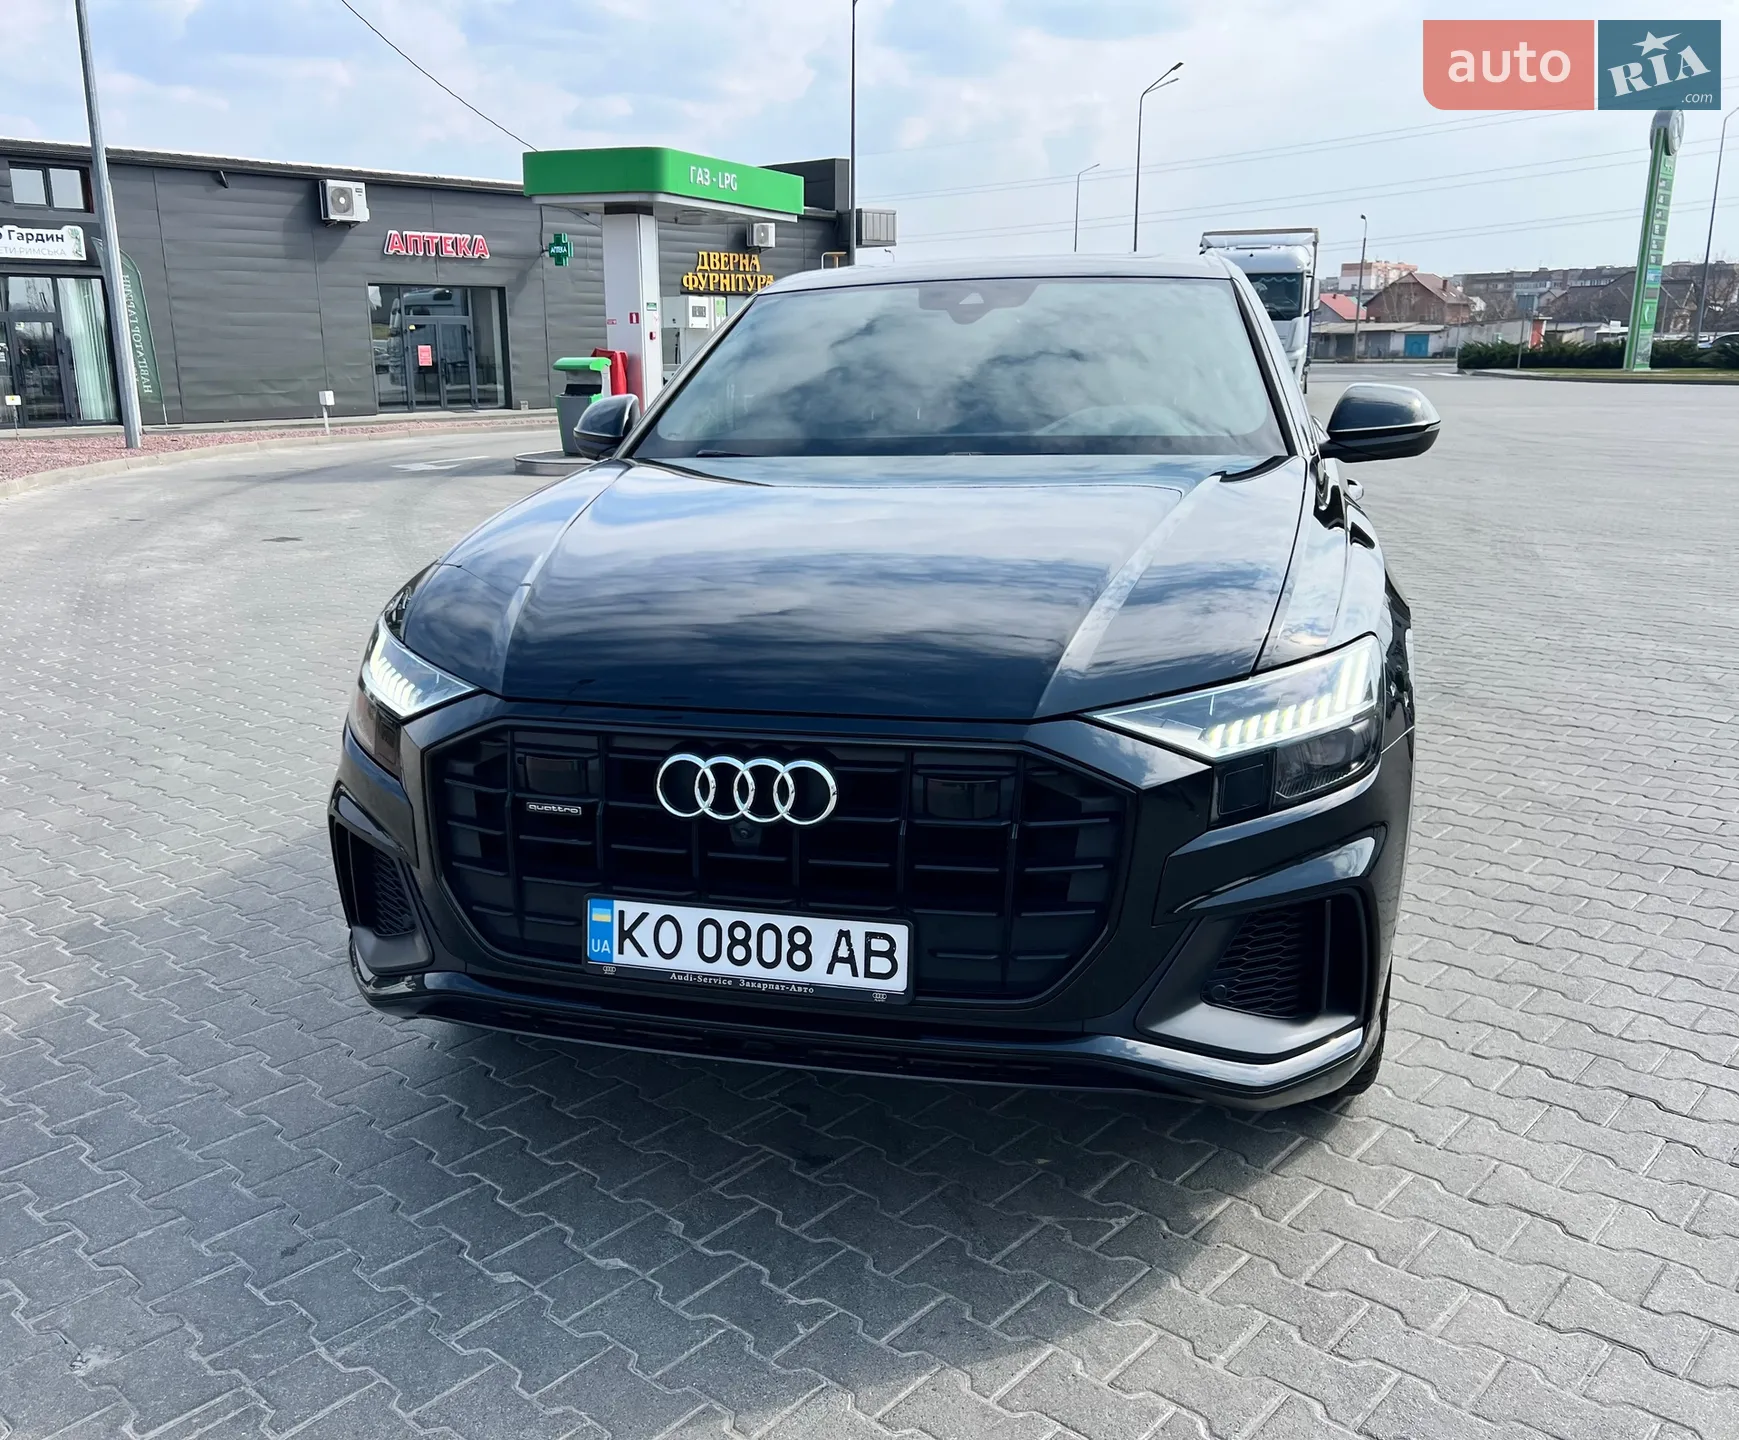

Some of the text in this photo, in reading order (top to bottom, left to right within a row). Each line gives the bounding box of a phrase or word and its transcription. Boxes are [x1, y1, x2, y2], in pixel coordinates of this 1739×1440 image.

[690, 166, 710, 186] ГАЗ
[718, 172, 738, 191] LPG
[8, 230, 64, 243] Гардин
[384, 230, 490, 260] АПТЕКА
[697, 251, 760, 272] ДВЕРНА
[529, 804, 579, 814] quattro
[591, 938, 611, 954] UA
[618, 909, 899, 980] KO 0808 AB
[670, 973, 814, 993] Audi-Service Закарпат-Авто
